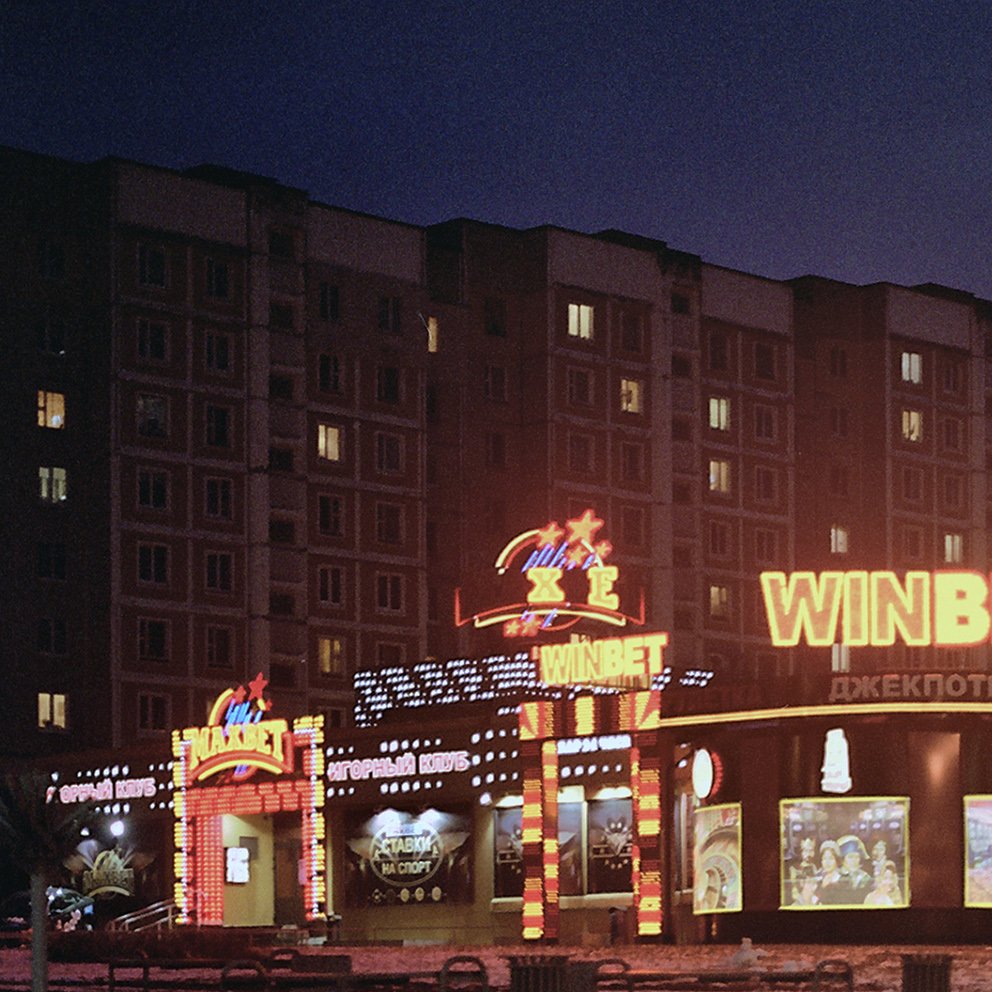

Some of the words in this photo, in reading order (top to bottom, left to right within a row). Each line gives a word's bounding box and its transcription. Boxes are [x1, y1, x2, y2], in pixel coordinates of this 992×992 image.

[539, 632, 668, 686] WINBET
[182, 719, 288, 770] MAXBET
[327, 752, 416, 781] ИГОРНЫЙ
[419, 750, 470, 774] КЛУБ
[381, 836, 432, 853] СТАВКИ
[382, 862, 396, 875] НА
[398, 860, 432, 875] СПОРТ
